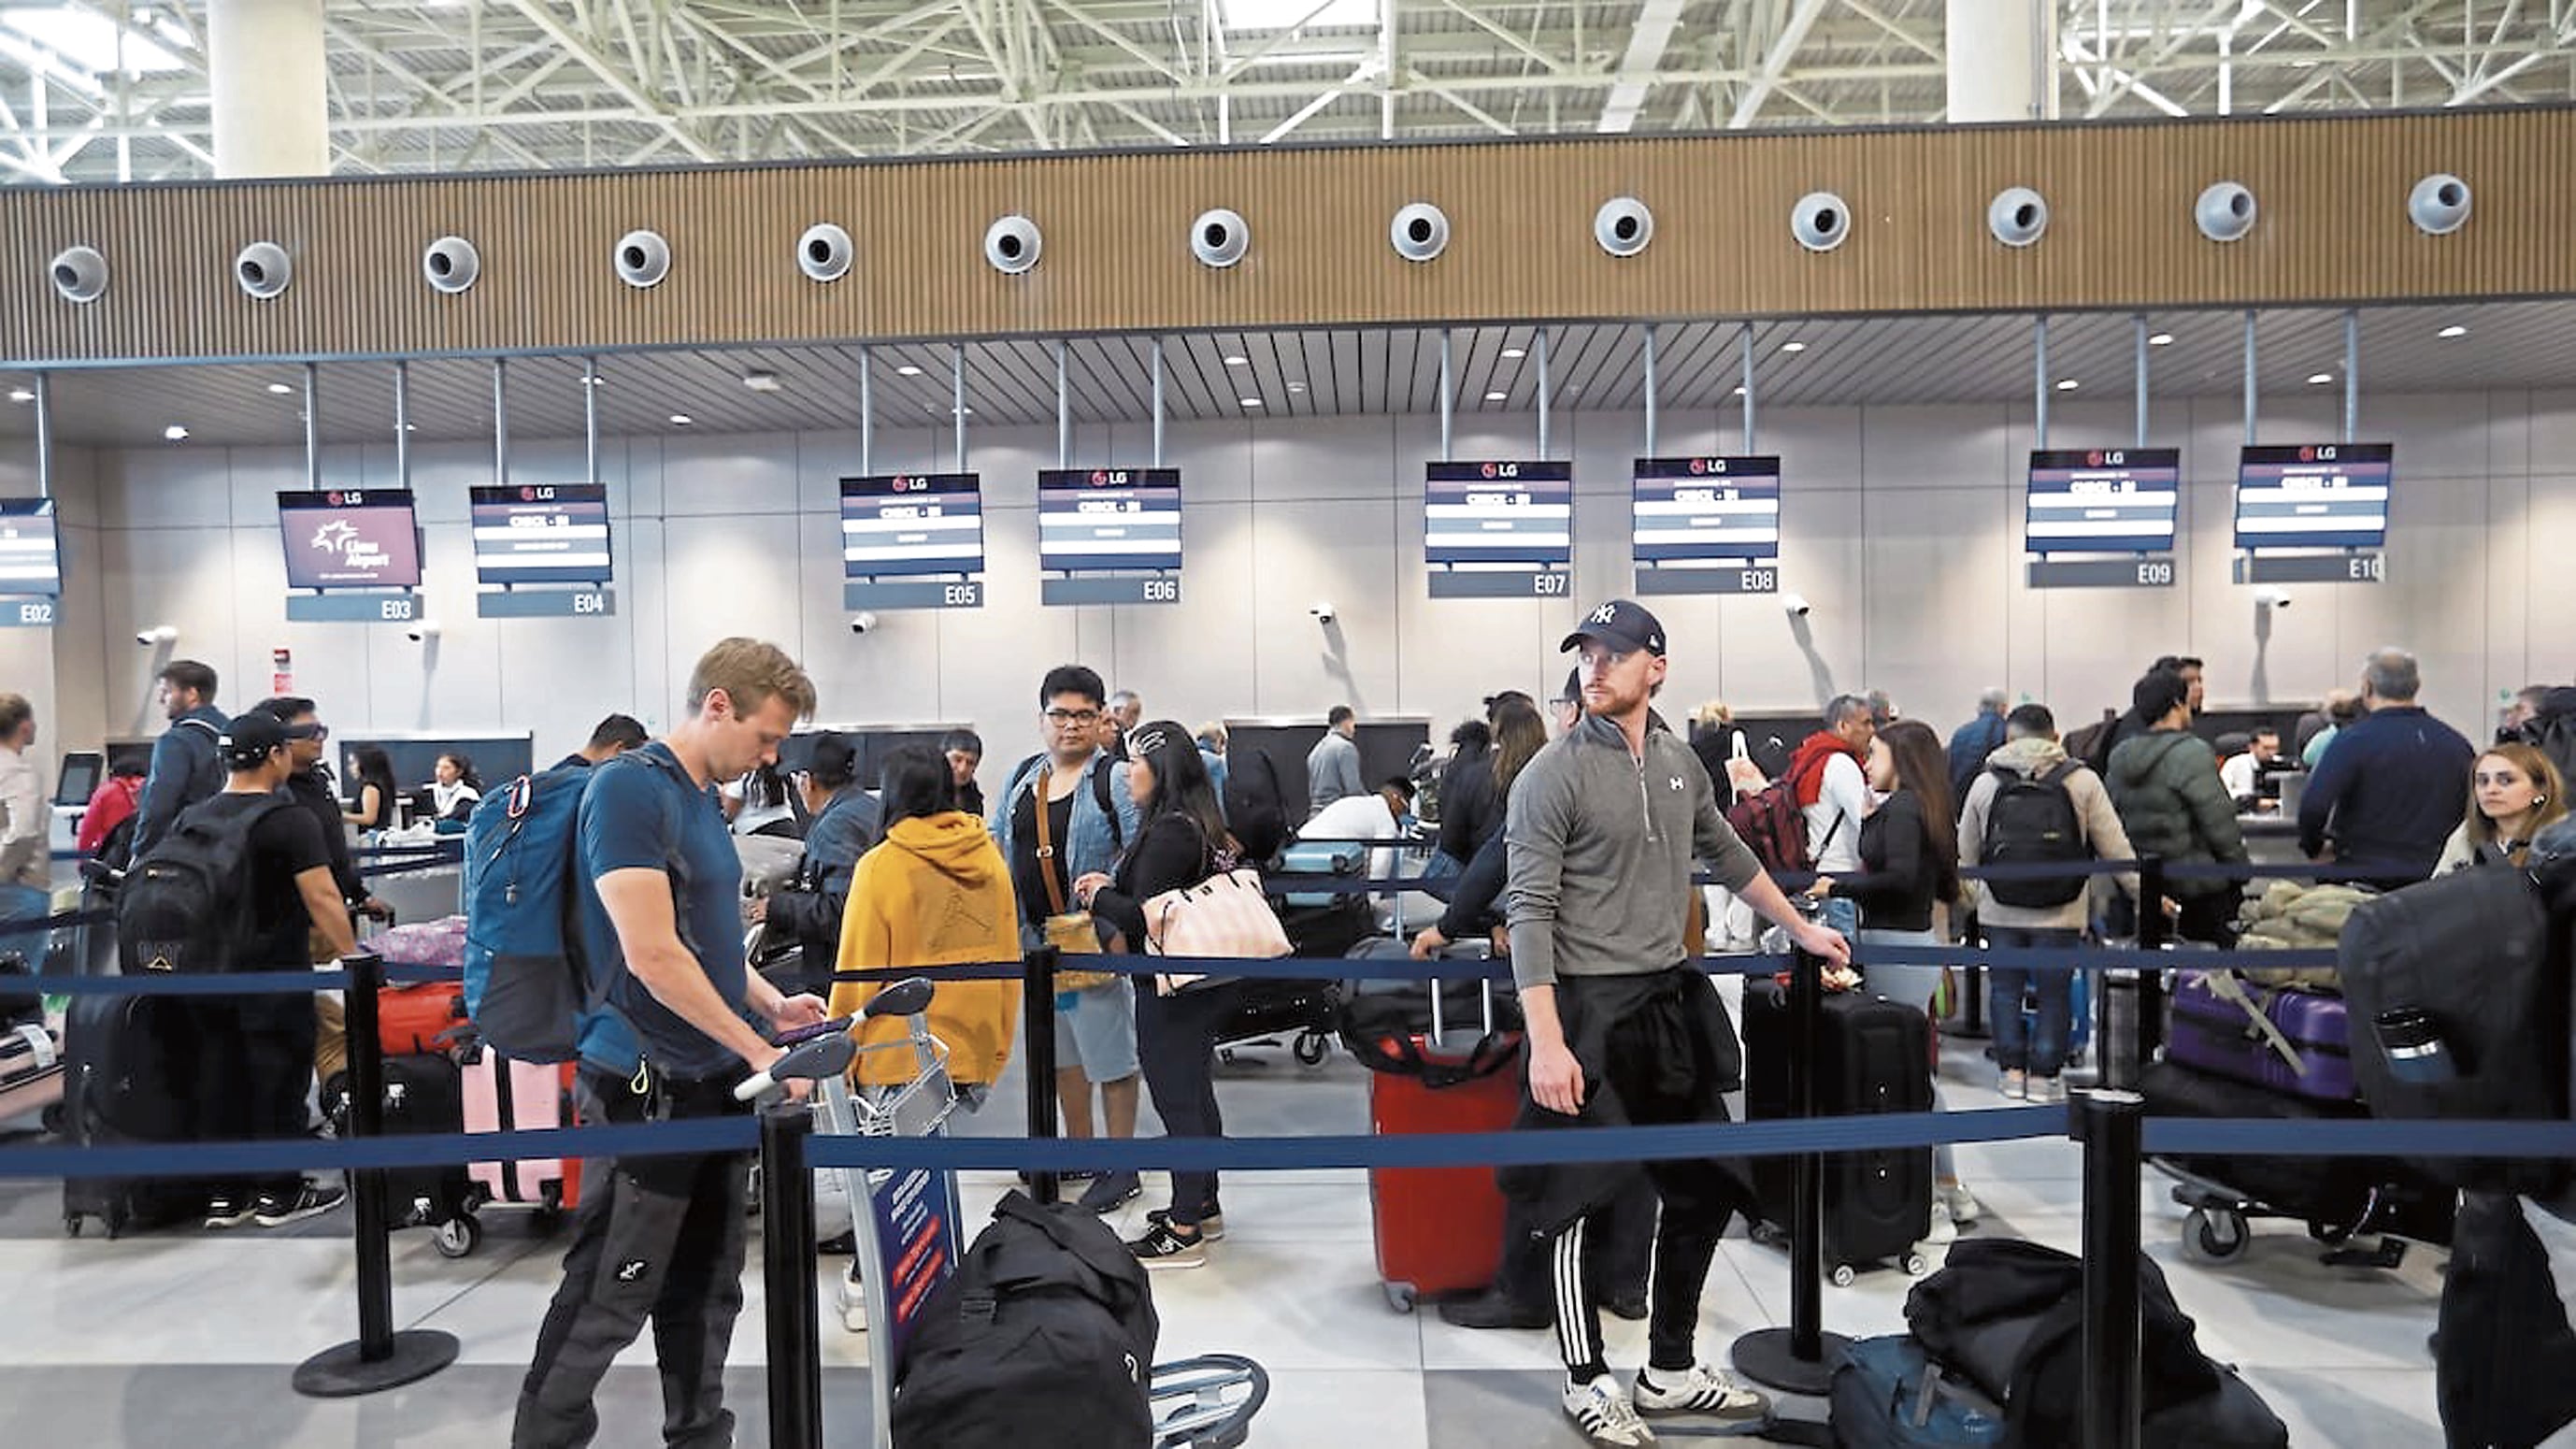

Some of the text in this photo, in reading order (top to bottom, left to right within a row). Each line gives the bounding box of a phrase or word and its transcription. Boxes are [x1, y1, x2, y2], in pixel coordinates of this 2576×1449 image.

[2105, 452, 2125, 465] LG
[2316, 446, 2337, 460] LG
[1498, 464, 1518, 477] LG
[1707, 459, 1726, 472] LG
[909, 478, 927, 490] LG
[1109, 471, 1127, 484] LG
[344, 492, 362, 505] LG
[537, 487, 554, 499] LG
[1741, 570, 1772, 590] E08
[2138, 564, 2171, 583] E09
[1144, 581, 1176, 600] E06
[1534, 575, 1566, 594] E07
[945, 585, 976, 604] E05
[381, 600, 411, 619] E03
[575, 594, 605, 612] E04
[20, 604, 52, 624] E02
